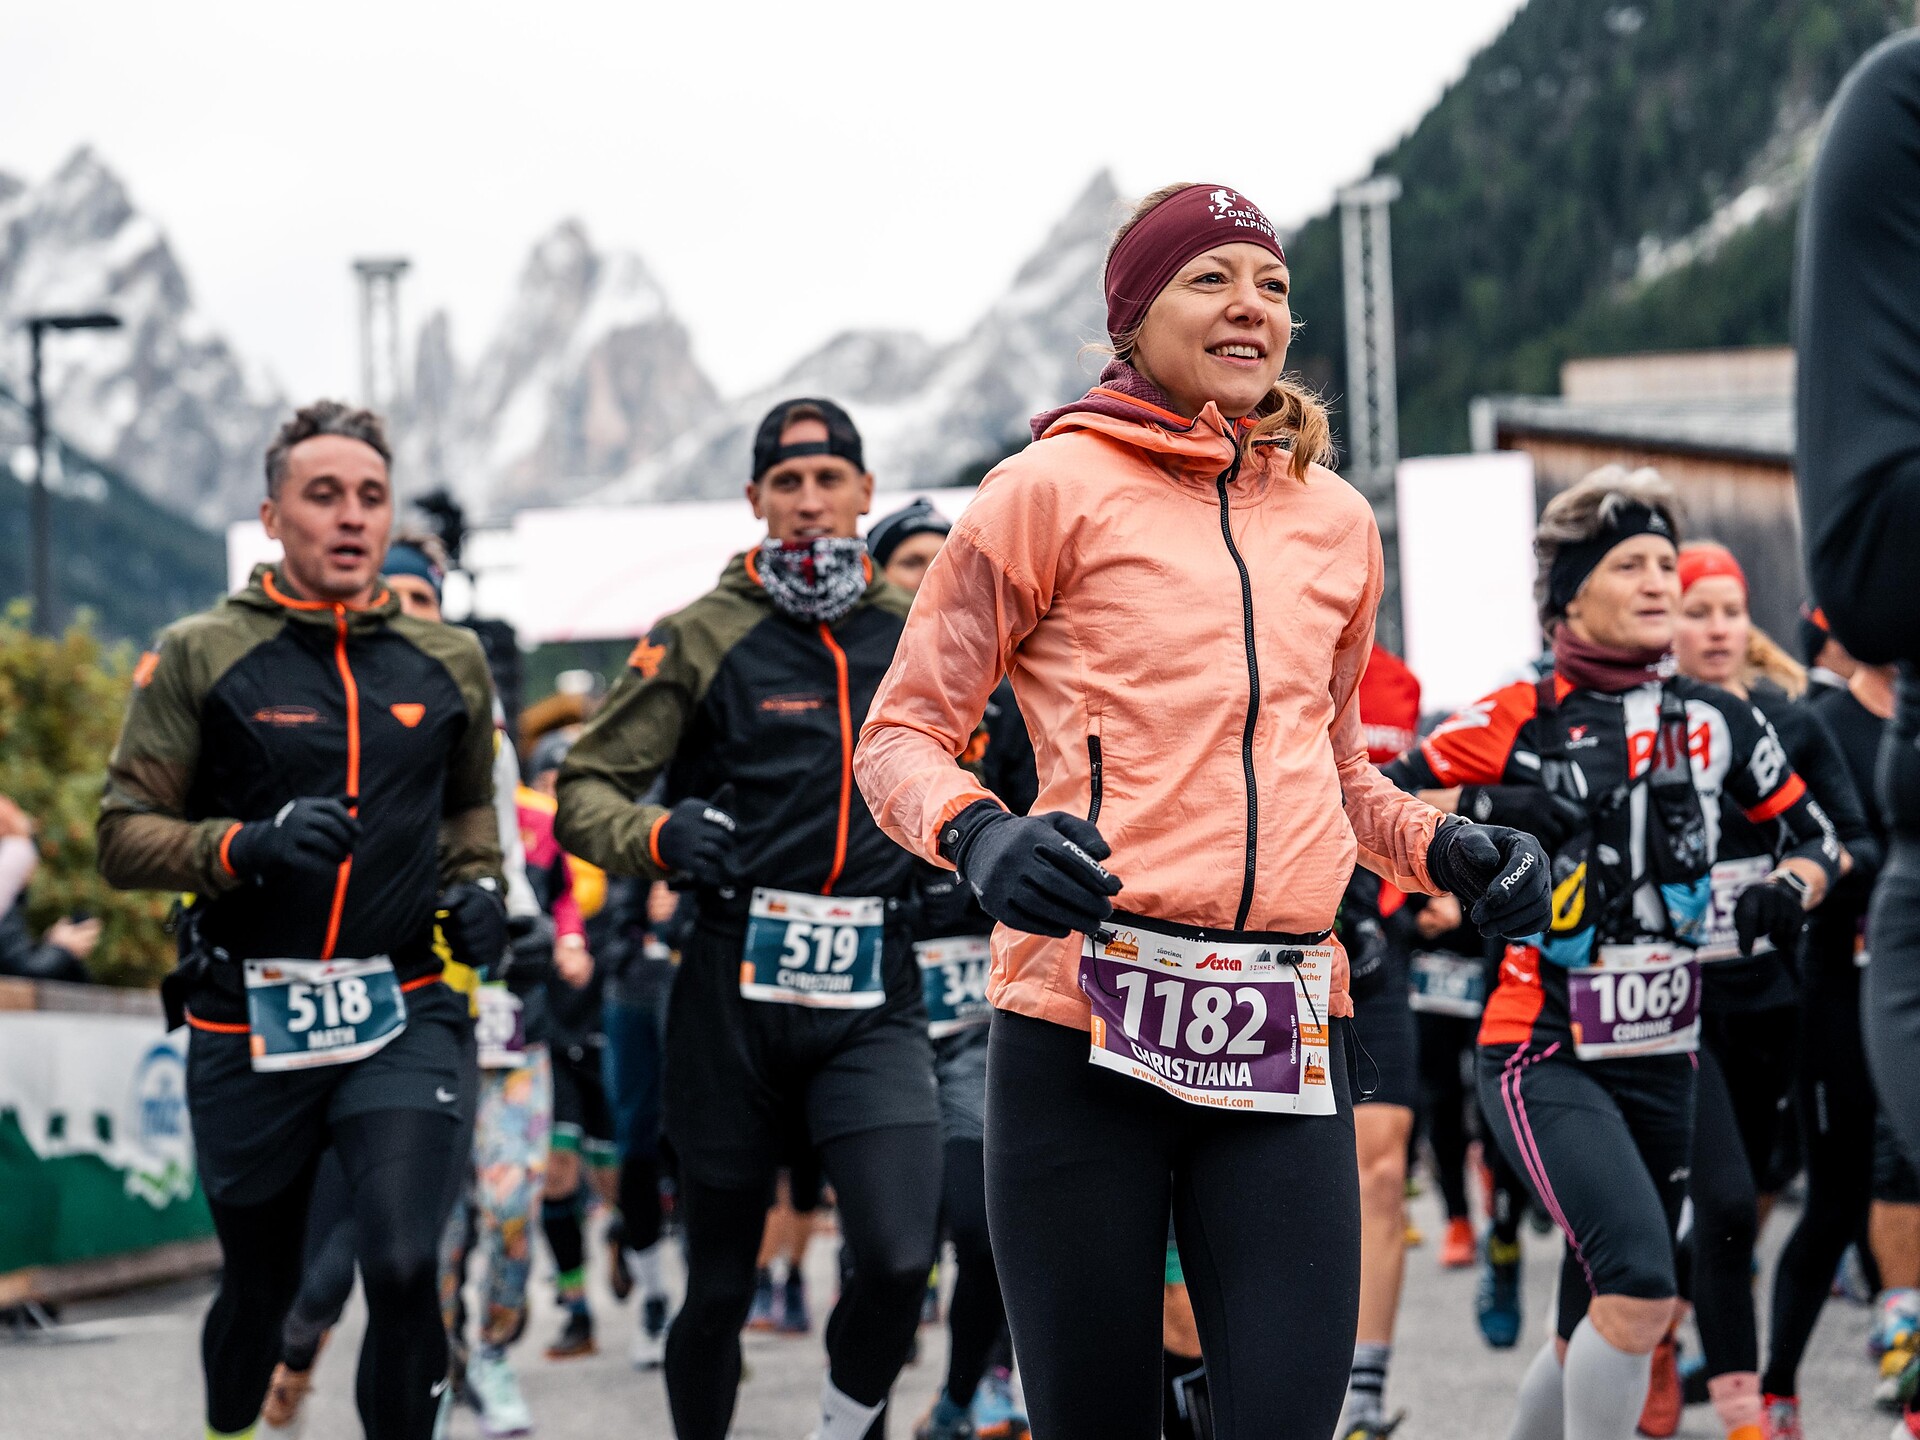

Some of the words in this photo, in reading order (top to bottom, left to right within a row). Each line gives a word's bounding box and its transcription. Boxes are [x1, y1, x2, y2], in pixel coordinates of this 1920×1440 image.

[1227, 210, 1256, 220] DREI
[1235, 218, 1272, 237] ALPINE
[1500, 852, 1535, 890] Roeckl
[778, 920, 860, 973] 519
[287, 976, 372, 1033] 518
[1116, 971, 1267, 1055] 1182
[1590, 965, 1692, 1023] 1069
[1130, 1041, 1253, 1087] CHRISTIANA
[1131, 1067, 1254, 1108] www.dreizinnenlauf.com
